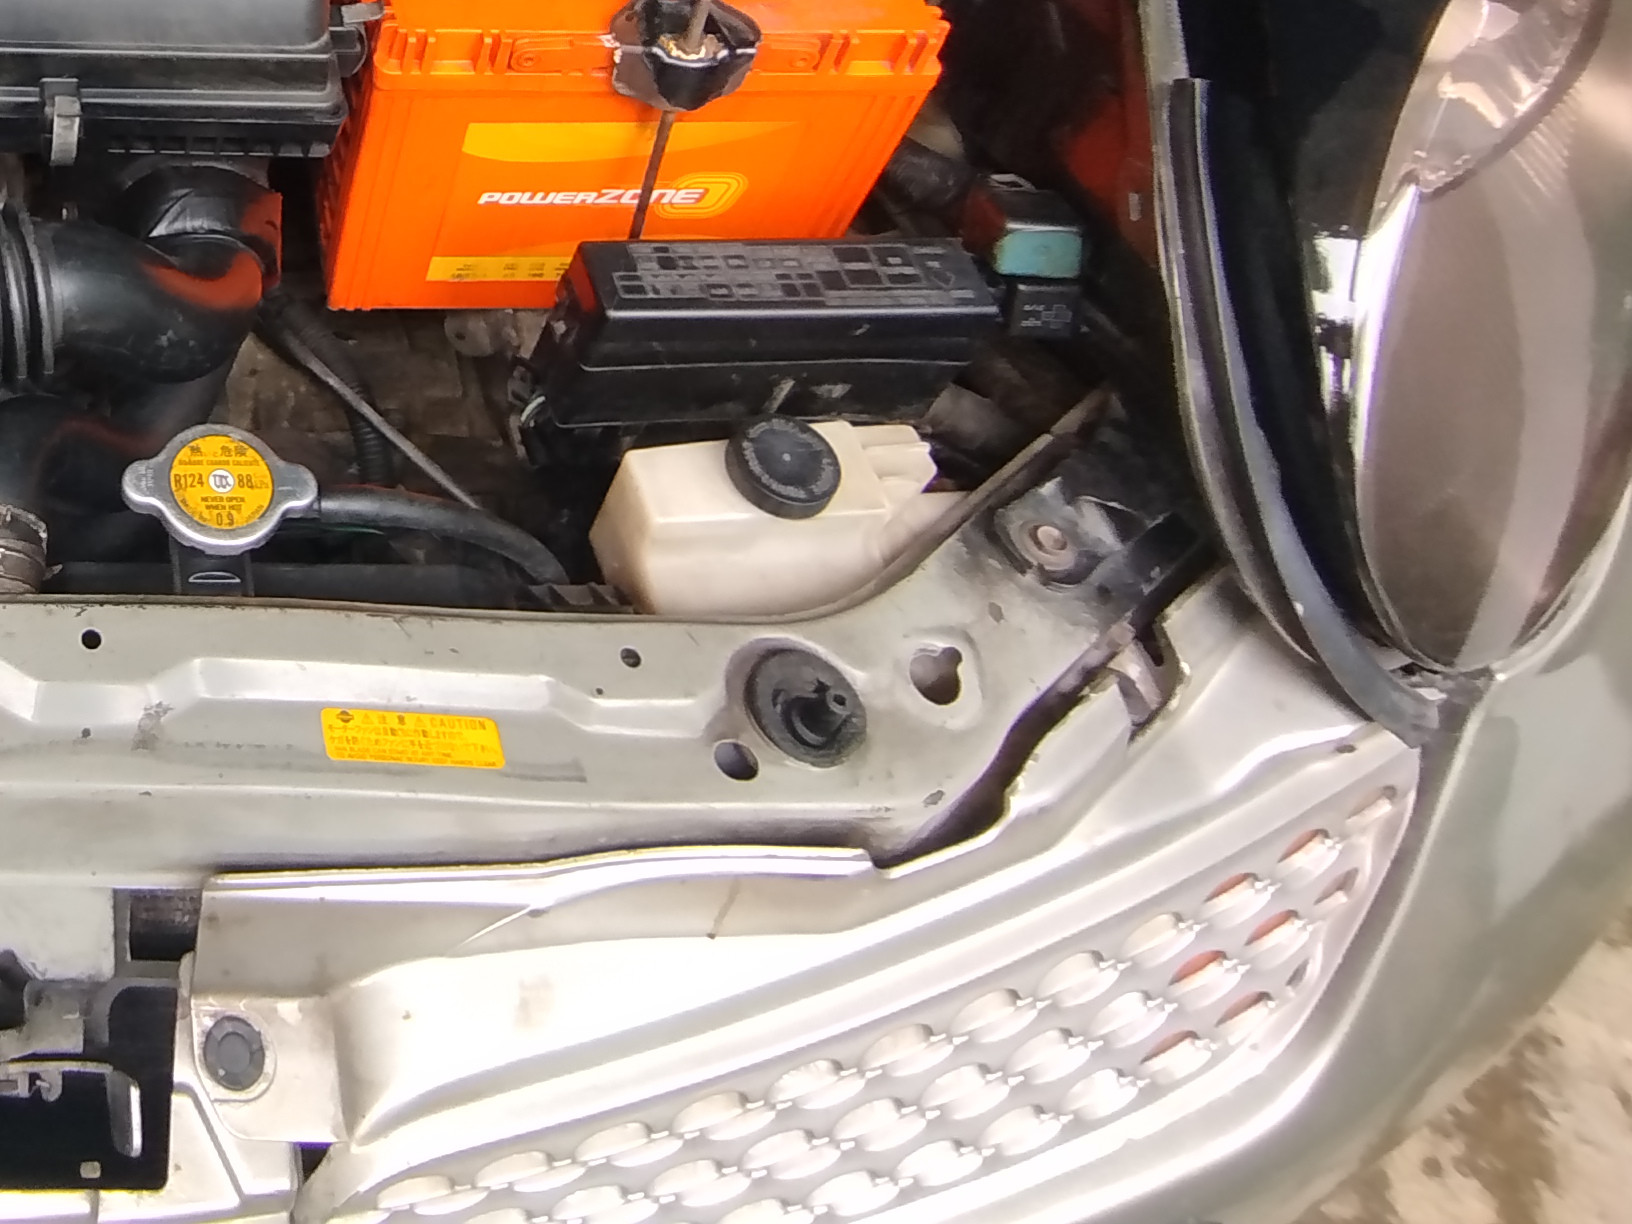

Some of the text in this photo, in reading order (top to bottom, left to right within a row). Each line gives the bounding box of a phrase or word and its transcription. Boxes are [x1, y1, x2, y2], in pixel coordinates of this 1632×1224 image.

[174, 473, 205, 489] R124
[237, 473, 254, 489] 88
[429, 717, 486, 730] CAUTION
